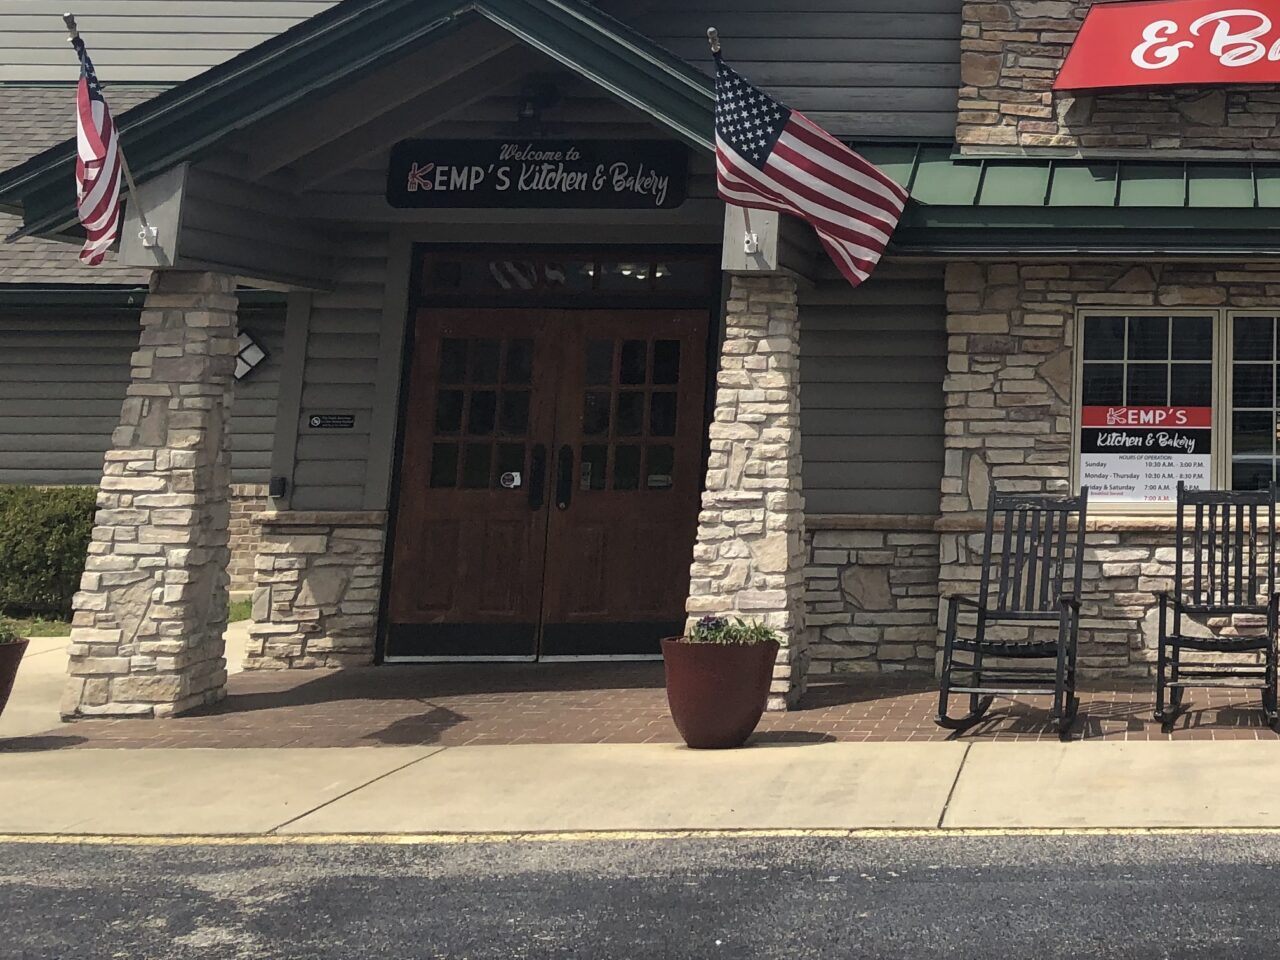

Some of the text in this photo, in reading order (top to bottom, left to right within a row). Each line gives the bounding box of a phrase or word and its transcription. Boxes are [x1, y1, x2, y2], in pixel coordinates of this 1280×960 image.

[1131, 20, 1194, 69] &
[499, 143, 582, 161] Welcome to
[407, 161, 670, 206] KEMP'S Kitchen & Bakery
[1106, 407, 1188, 424] KEMP'S
[1096, 431, 1196, 454] Kitchen & Bakery
